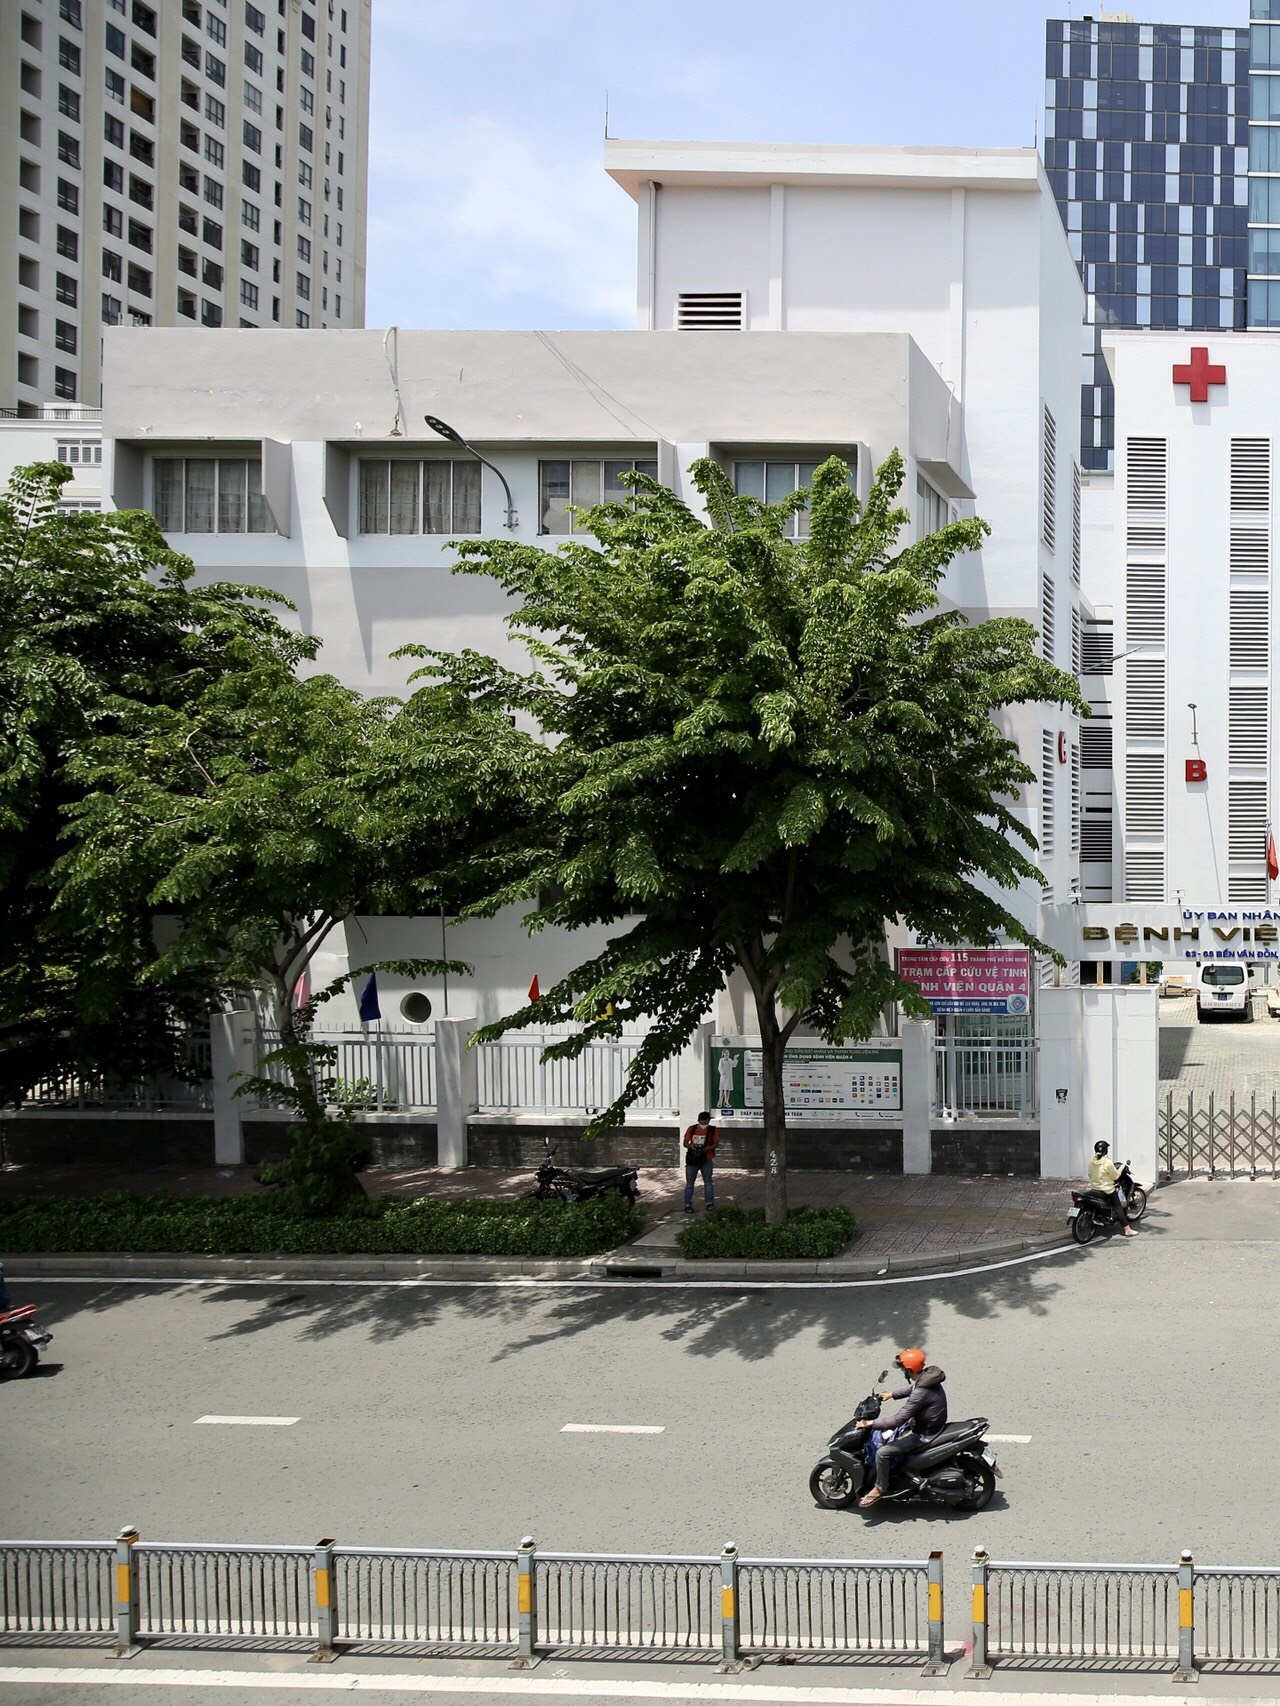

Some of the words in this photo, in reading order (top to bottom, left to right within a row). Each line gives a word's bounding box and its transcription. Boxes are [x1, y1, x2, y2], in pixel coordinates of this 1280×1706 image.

[1185, 759, 1207, 782] B
[1183, 908, 1204, 920] ỦY
[1208, 912, 1237, 920] BAN
[1083, 923, 1199, 945] BỆNH
[951, 953, 969, 962] 115
[1216, 948, 1235, 958] BẾN
[902, 967, 933, 978] TRẠM
[936, 965, 957, 976] CẤP
[960, 966, 982, 977] CỨU
[985, 966, 998, 978] VỆ
[1002, 968, 1027, 977] TINH
[944, 980, 974, 993] VIỆN
[978, 980, 1014, 993] QUẬN
[1018, 983, 1027, 992] 4
